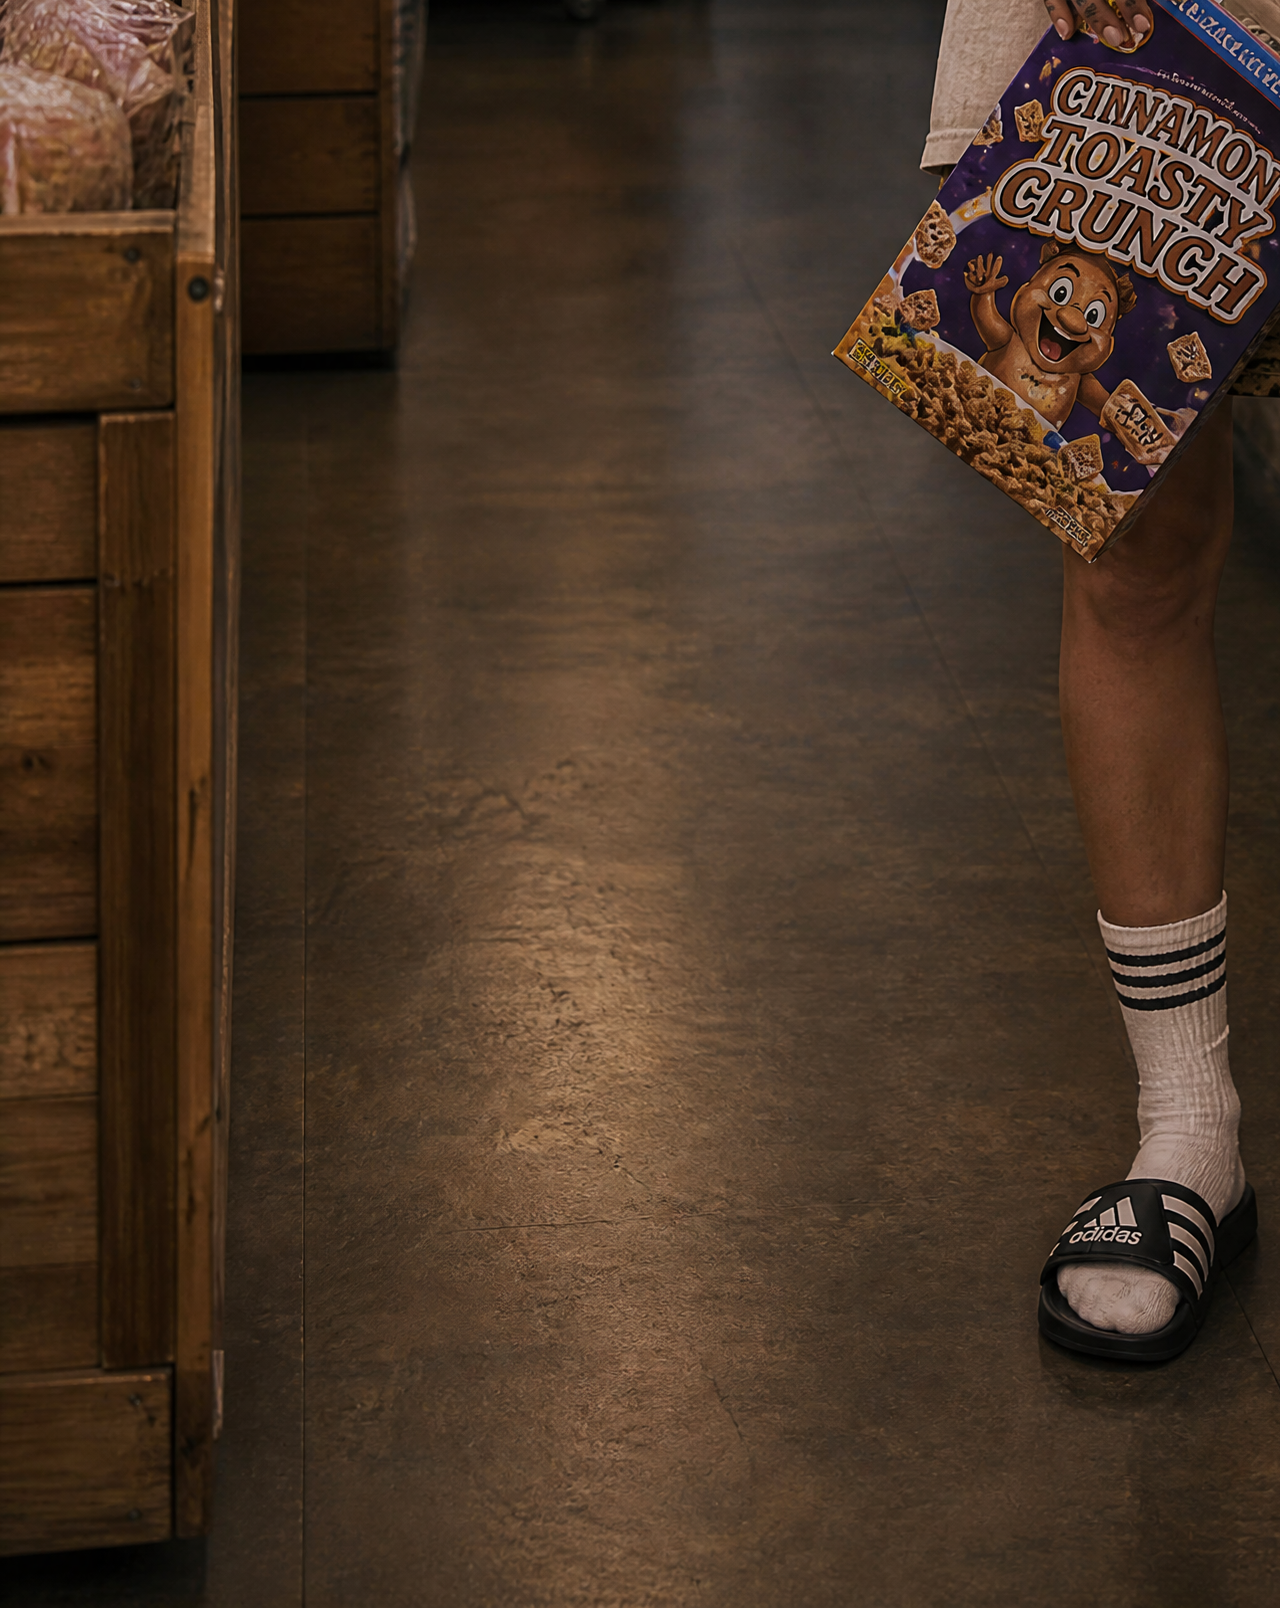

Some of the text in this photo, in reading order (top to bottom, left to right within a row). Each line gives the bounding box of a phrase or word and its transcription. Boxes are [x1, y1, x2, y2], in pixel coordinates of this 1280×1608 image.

[1000, 166, 1261, 315] CRUNCH
[1040, 118, 1269, 250] TOASTY
[1068, 1225, 1143, 1245] adidas
